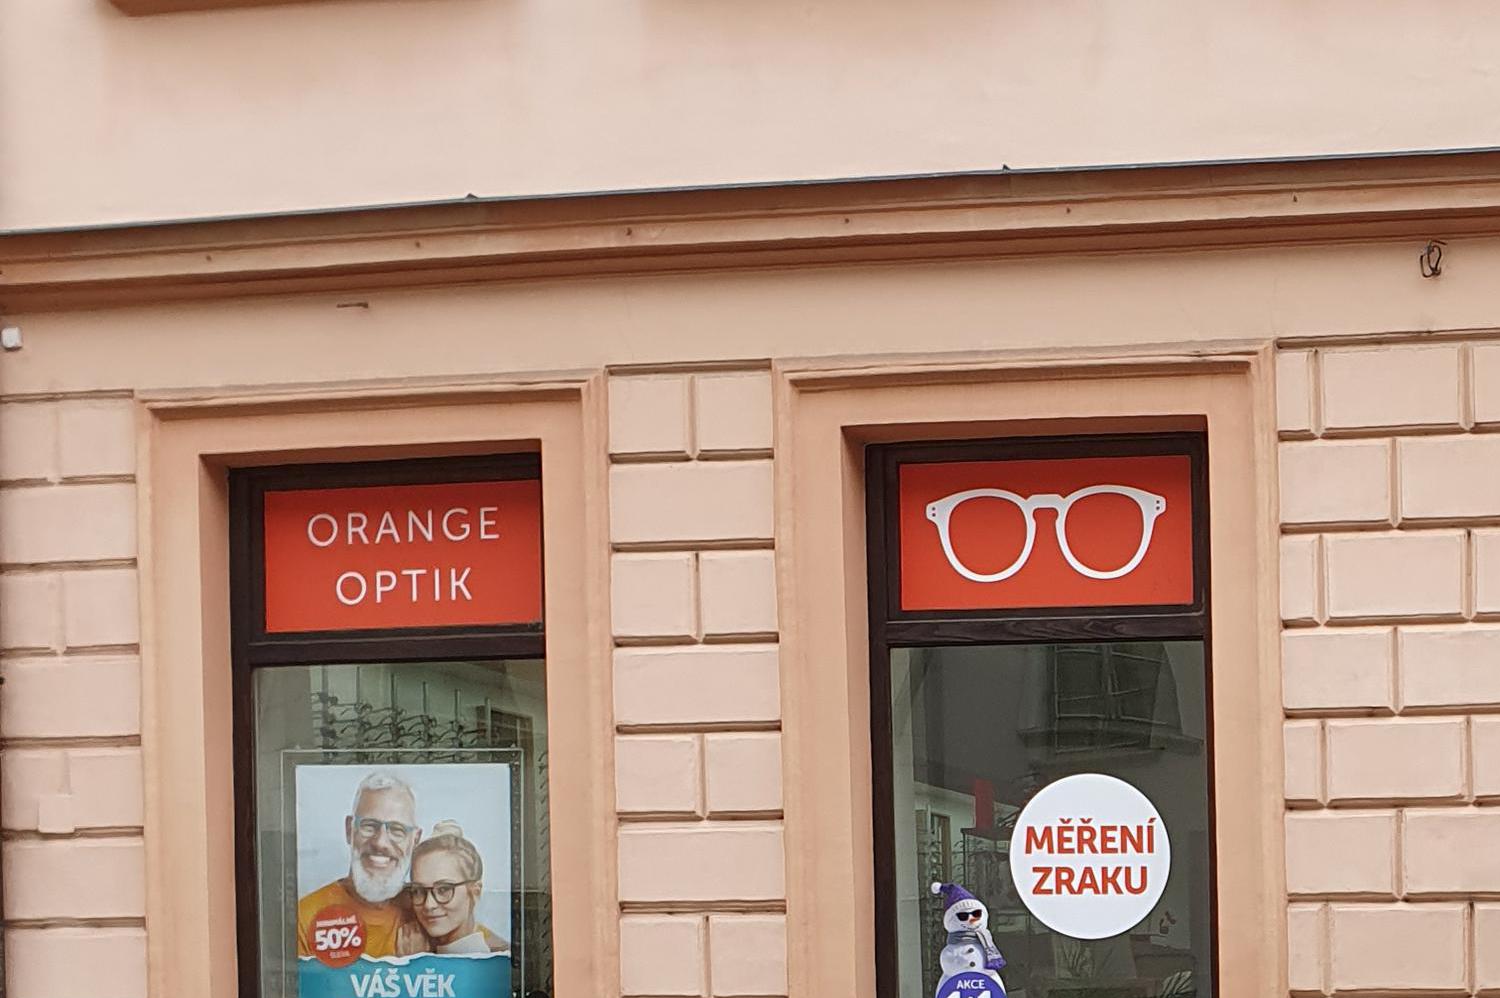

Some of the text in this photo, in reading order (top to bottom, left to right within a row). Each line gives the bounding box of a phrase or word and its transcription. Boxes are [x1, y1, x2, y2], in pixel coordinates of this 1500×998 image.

[307, 506, 500, 548] ORANGE
[335, 567, 472, 606] OPTIK
[1025, 817, 1157, 855] MĚŘENÍ
[1032, 866, 1148, 895] ZRAKU
[315, 925, 361, 951] 50%
[350, 967, 456, 998] VÁŠ VĚK
[956, 979, 986, 990] AKCE
